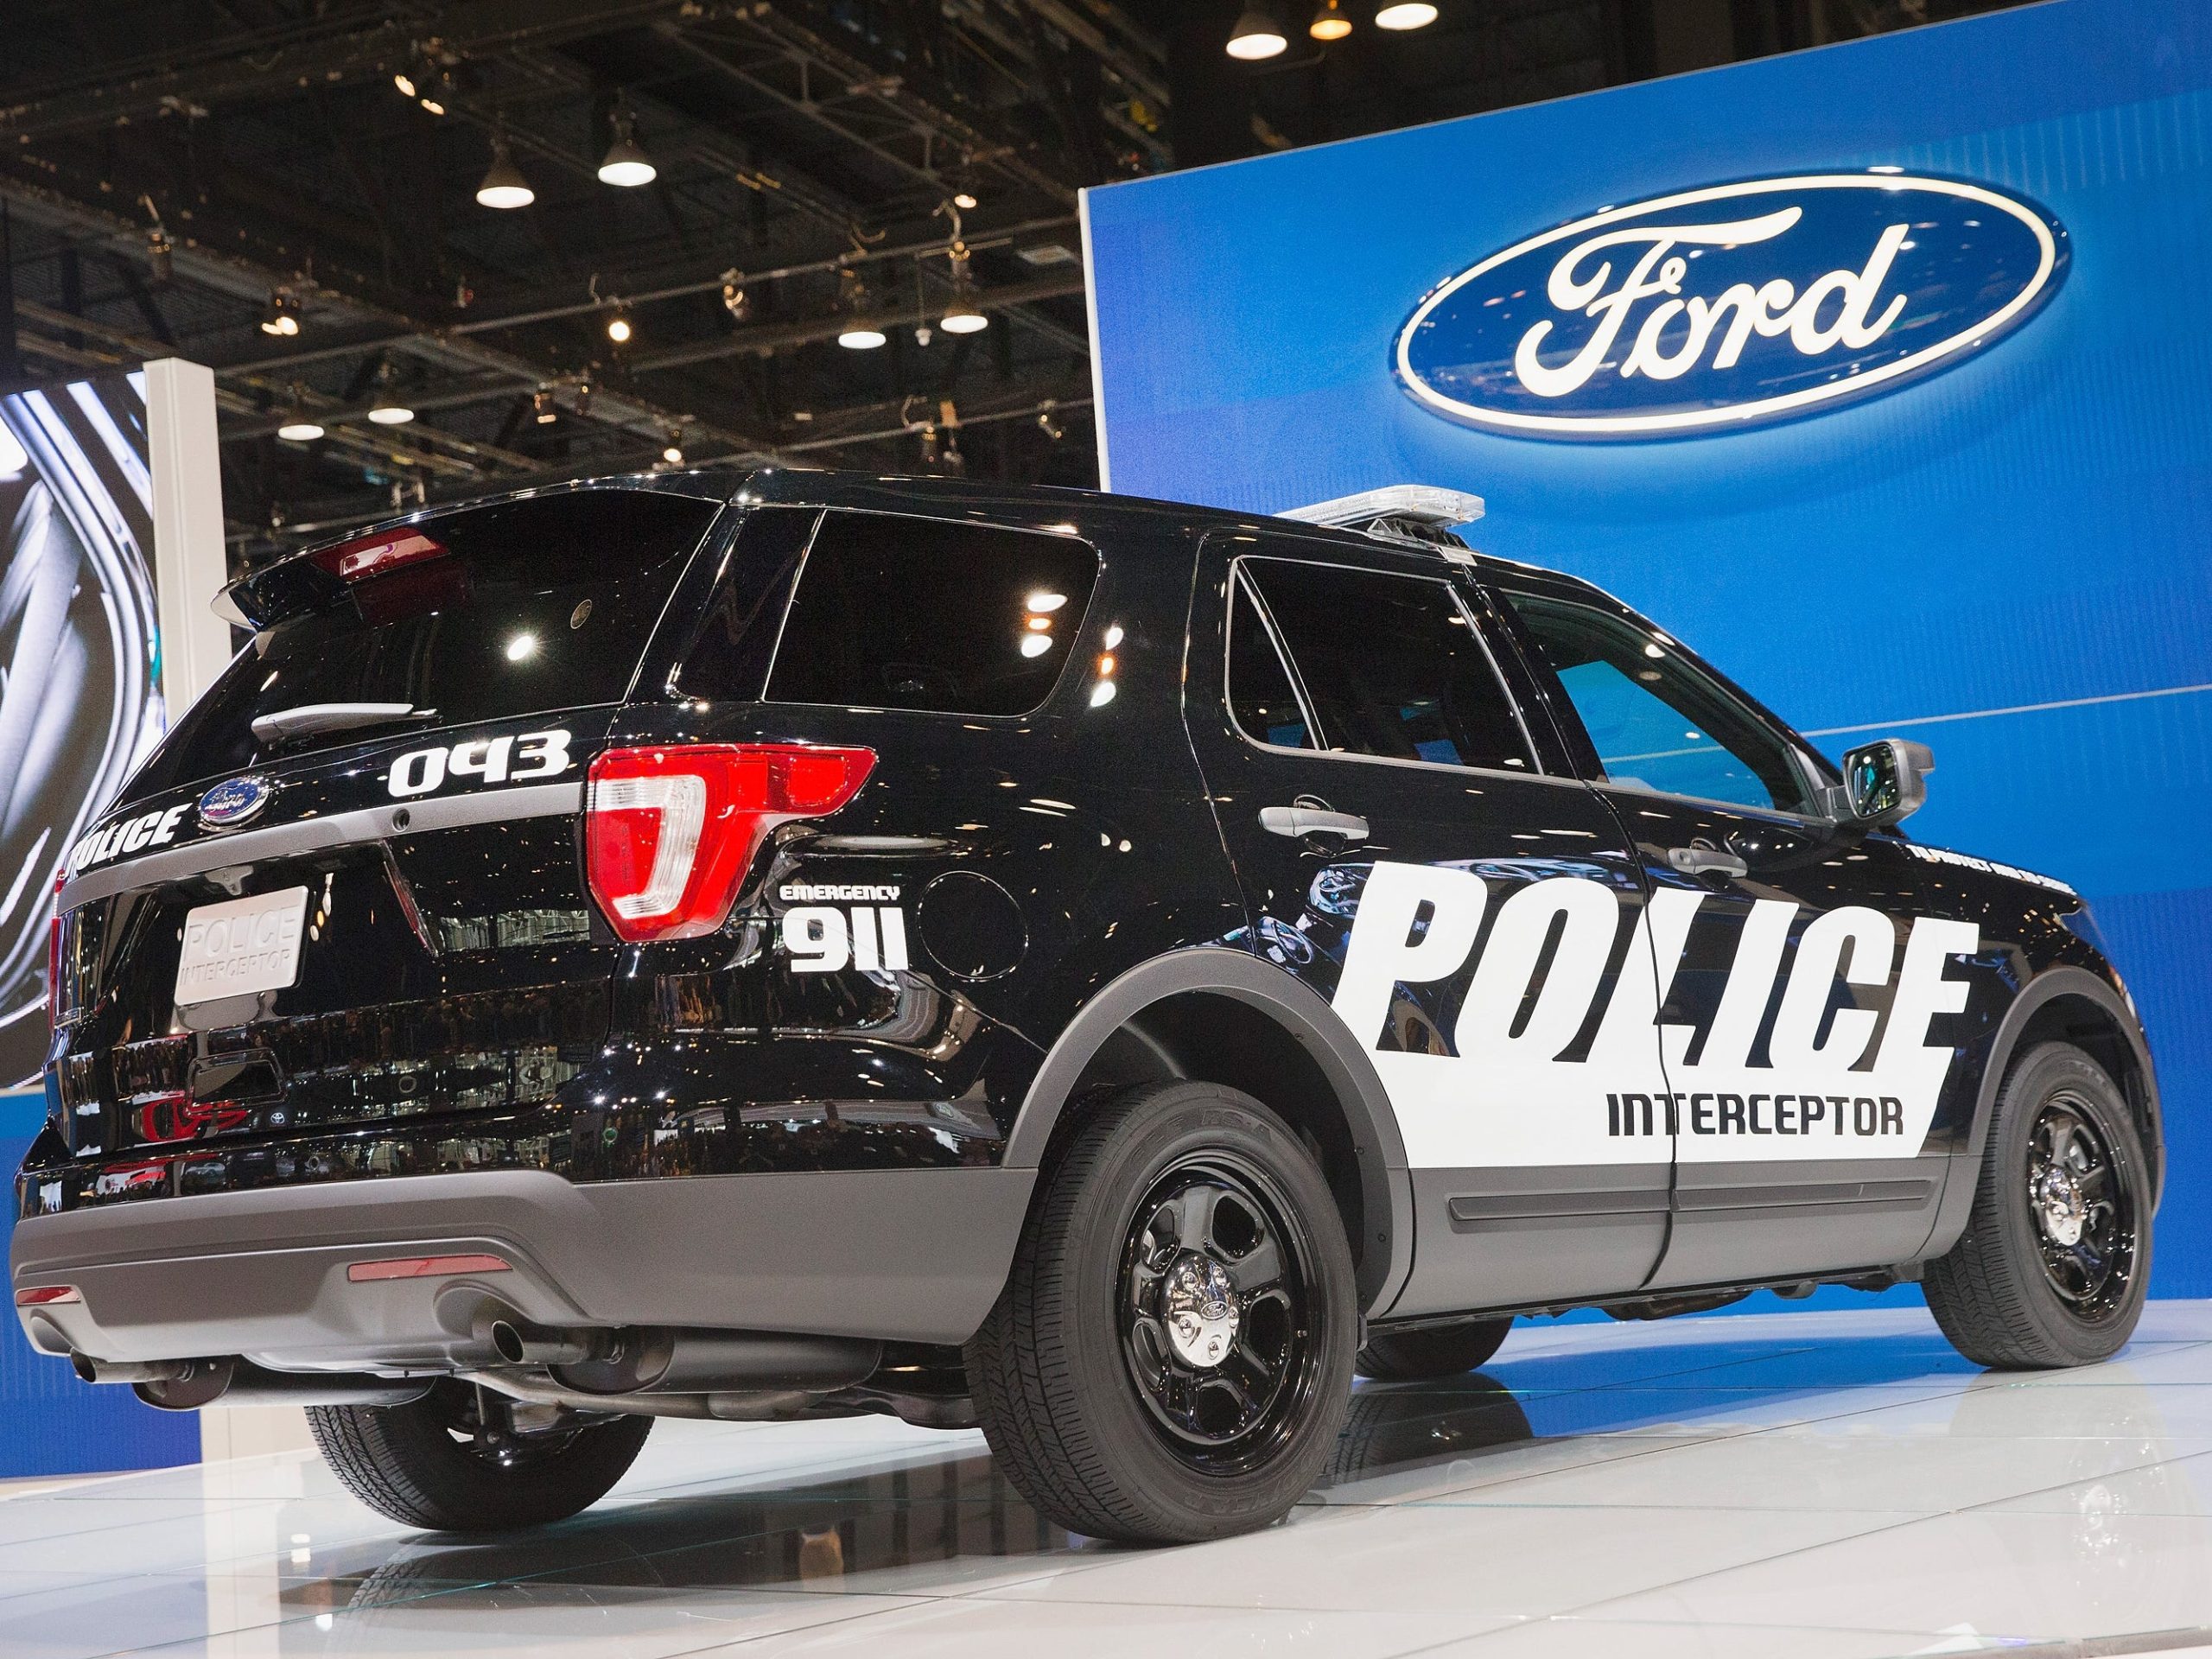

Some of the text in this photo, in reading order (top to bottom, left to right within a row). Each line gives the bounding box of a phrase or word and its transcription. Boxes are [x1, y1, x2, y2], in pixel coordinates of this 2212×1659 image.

[1515, 206, 1909, 397] Ford
[387, 729, 572, 797] 043
[779, 884, 901, 900] EMERGENCY
[184, 905, 301, 962] POLICE
[782, 906, 909, 973] 911
[179, 948, 291, 986] INTERCEPTOR
[1332, 860, 1980, 1073] POLICE
[1606, 1092, 1904, 1137] INTERCEPTOR
